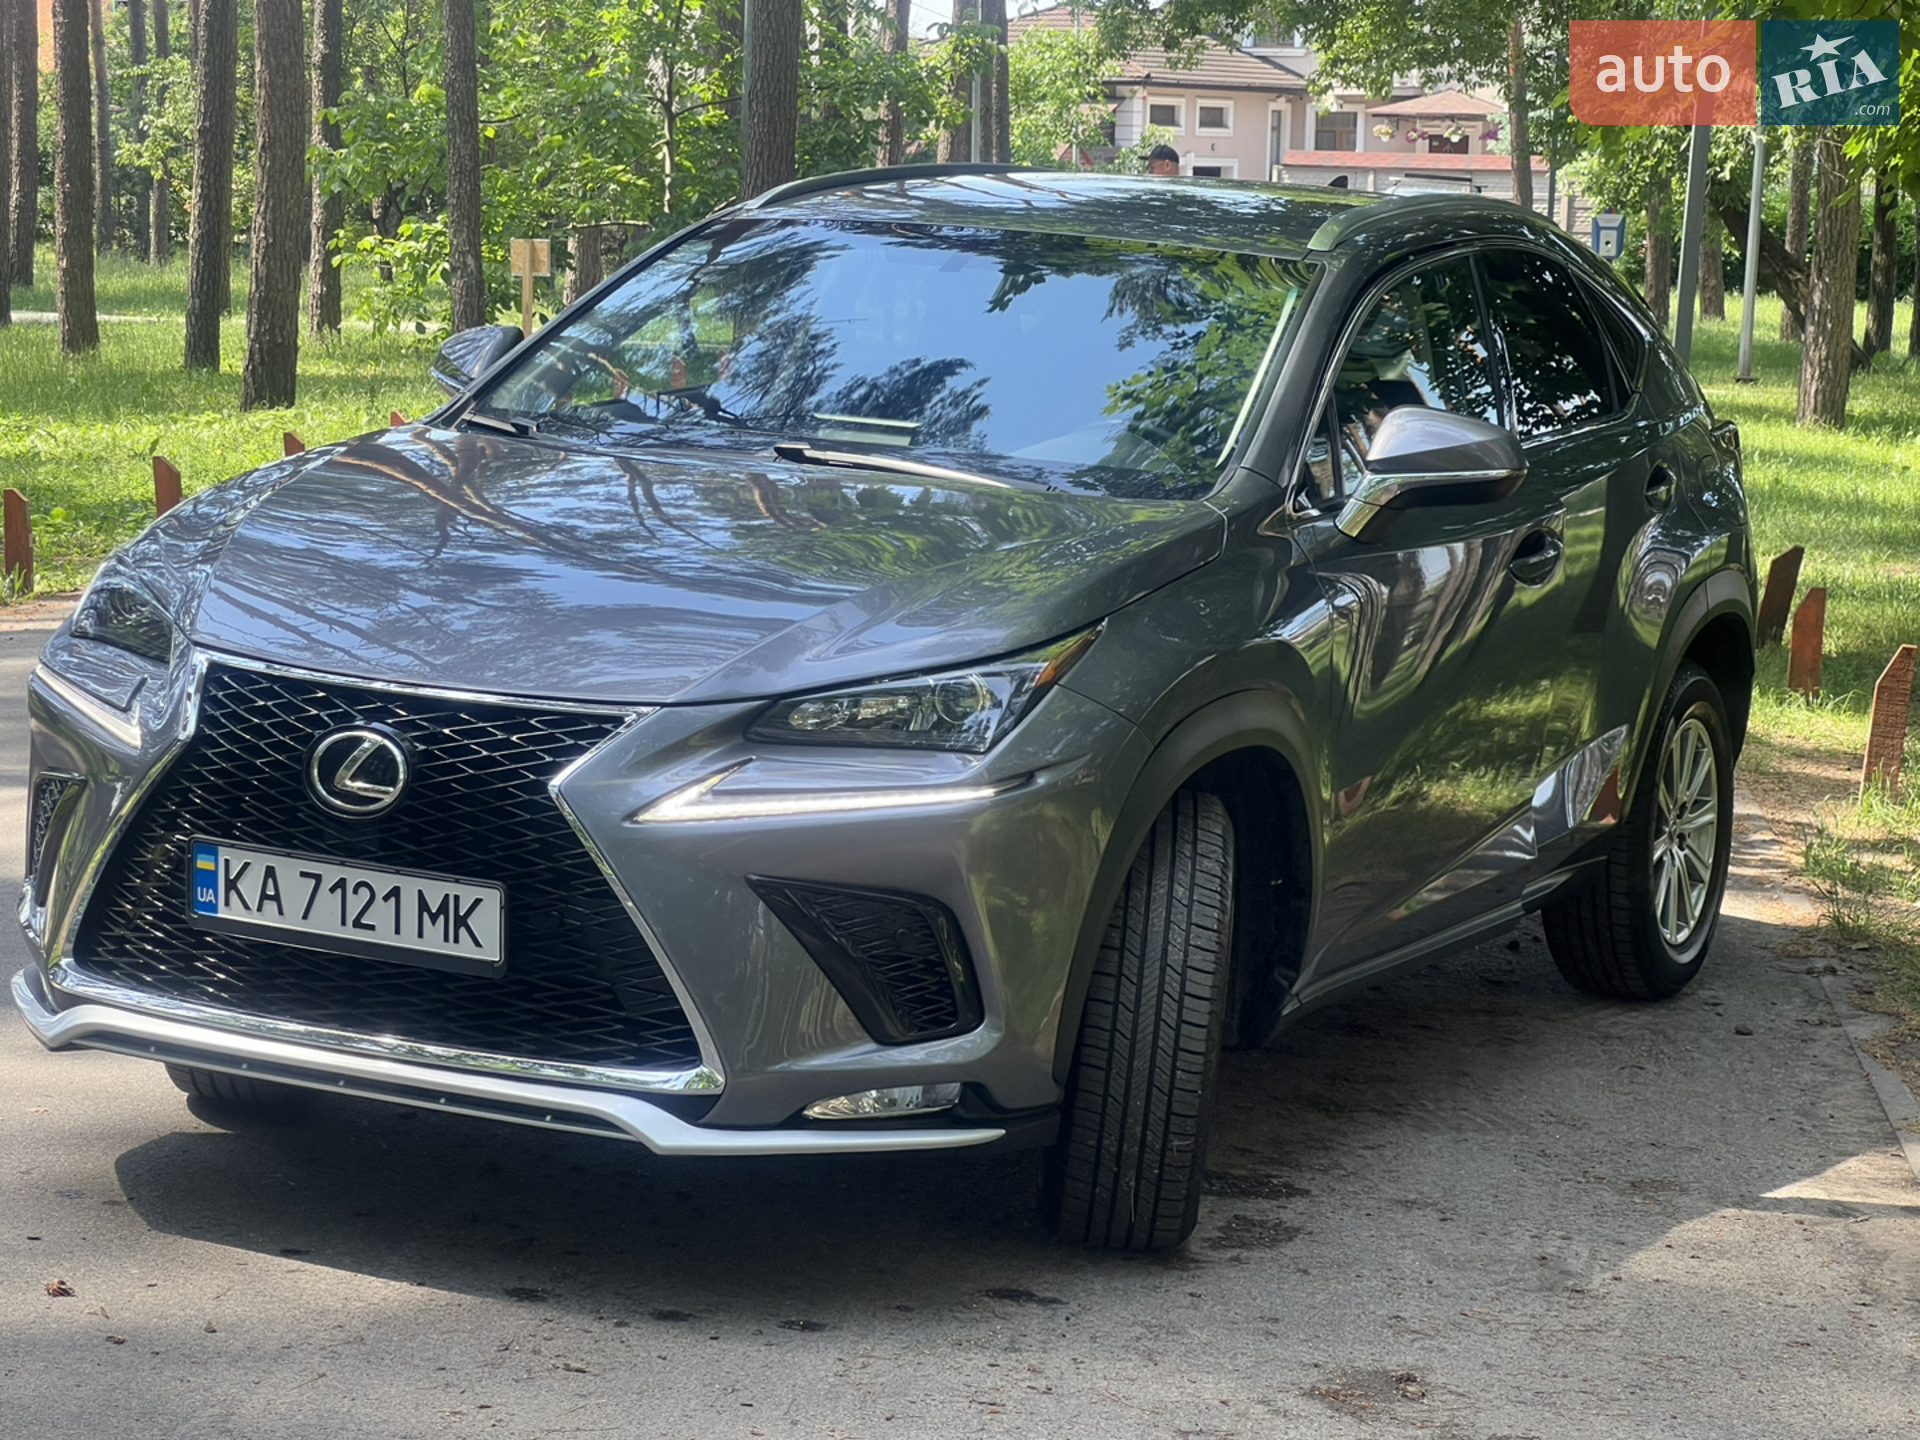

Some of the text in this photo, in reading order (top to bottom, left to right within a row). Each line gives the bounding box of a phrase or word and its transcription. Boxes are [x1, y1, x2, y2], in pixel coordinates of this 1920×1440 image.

[197, 887, 216, 904] UA
[223, 857, 484, 948] KA 7121 MK
